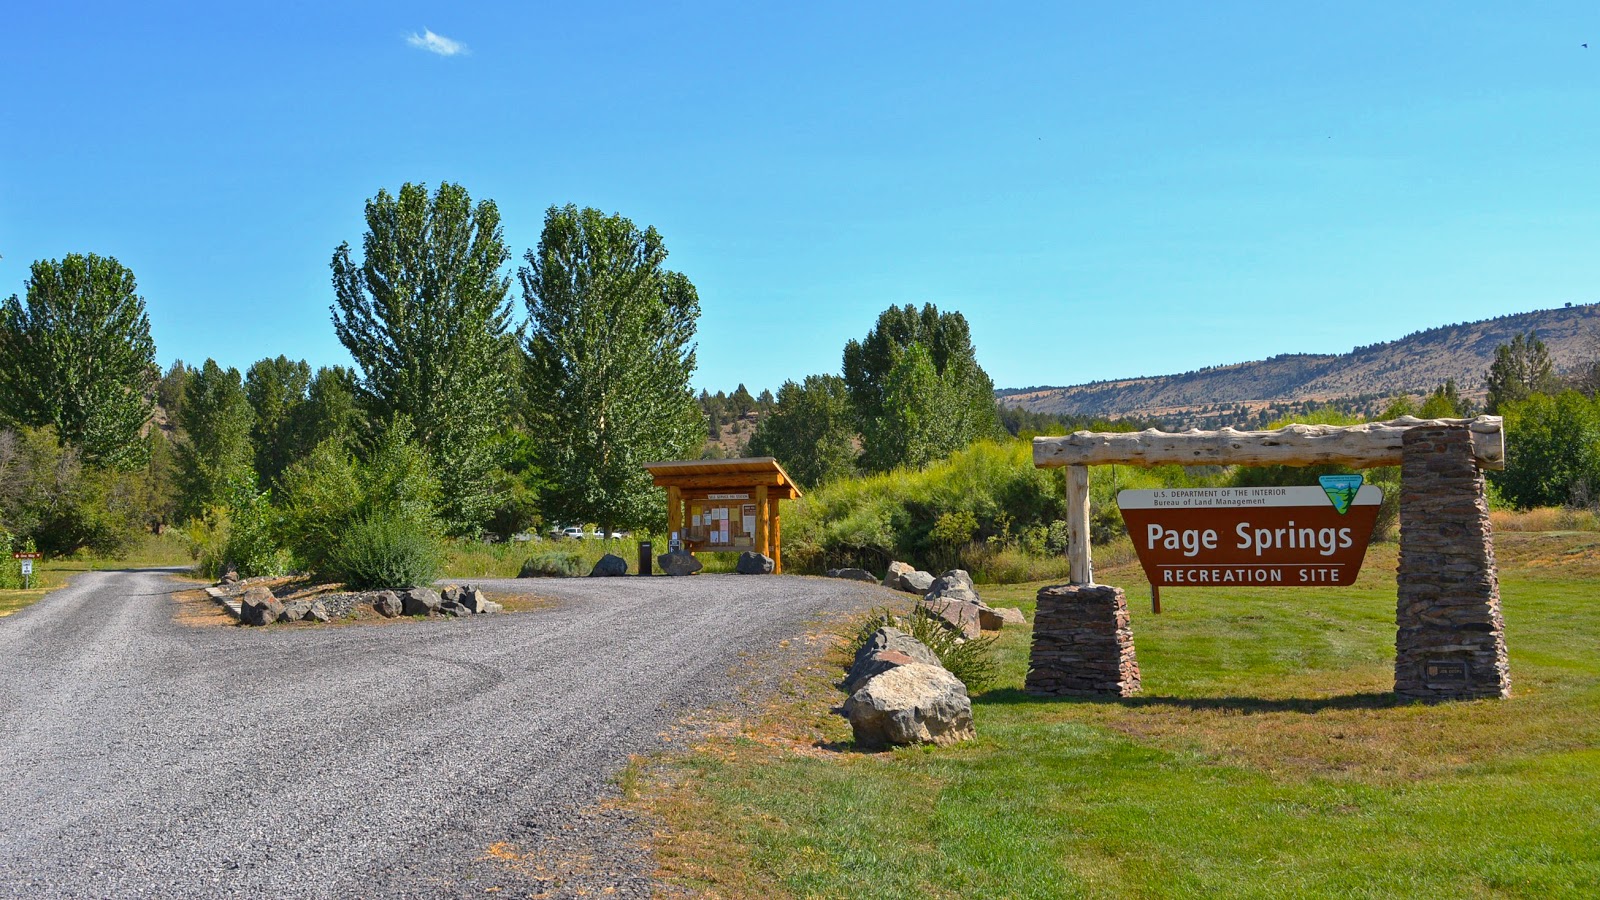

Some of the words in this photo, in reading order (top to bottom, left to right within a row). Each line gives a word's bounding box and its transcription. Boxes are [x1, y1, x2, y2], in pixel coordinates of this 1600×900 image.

[1171, 490, 1218, 498] DEPARTMENT
[1235, 489, 1248, 497] THE
[1215, 498, 1266, 507] Management
[1147, 523, 1218, 557] Page
[1235, 520, 1353, 556] Springs
[1163, 569, 1282, 582] RECREATION
[1299, 569, 1339, 582] SITE
